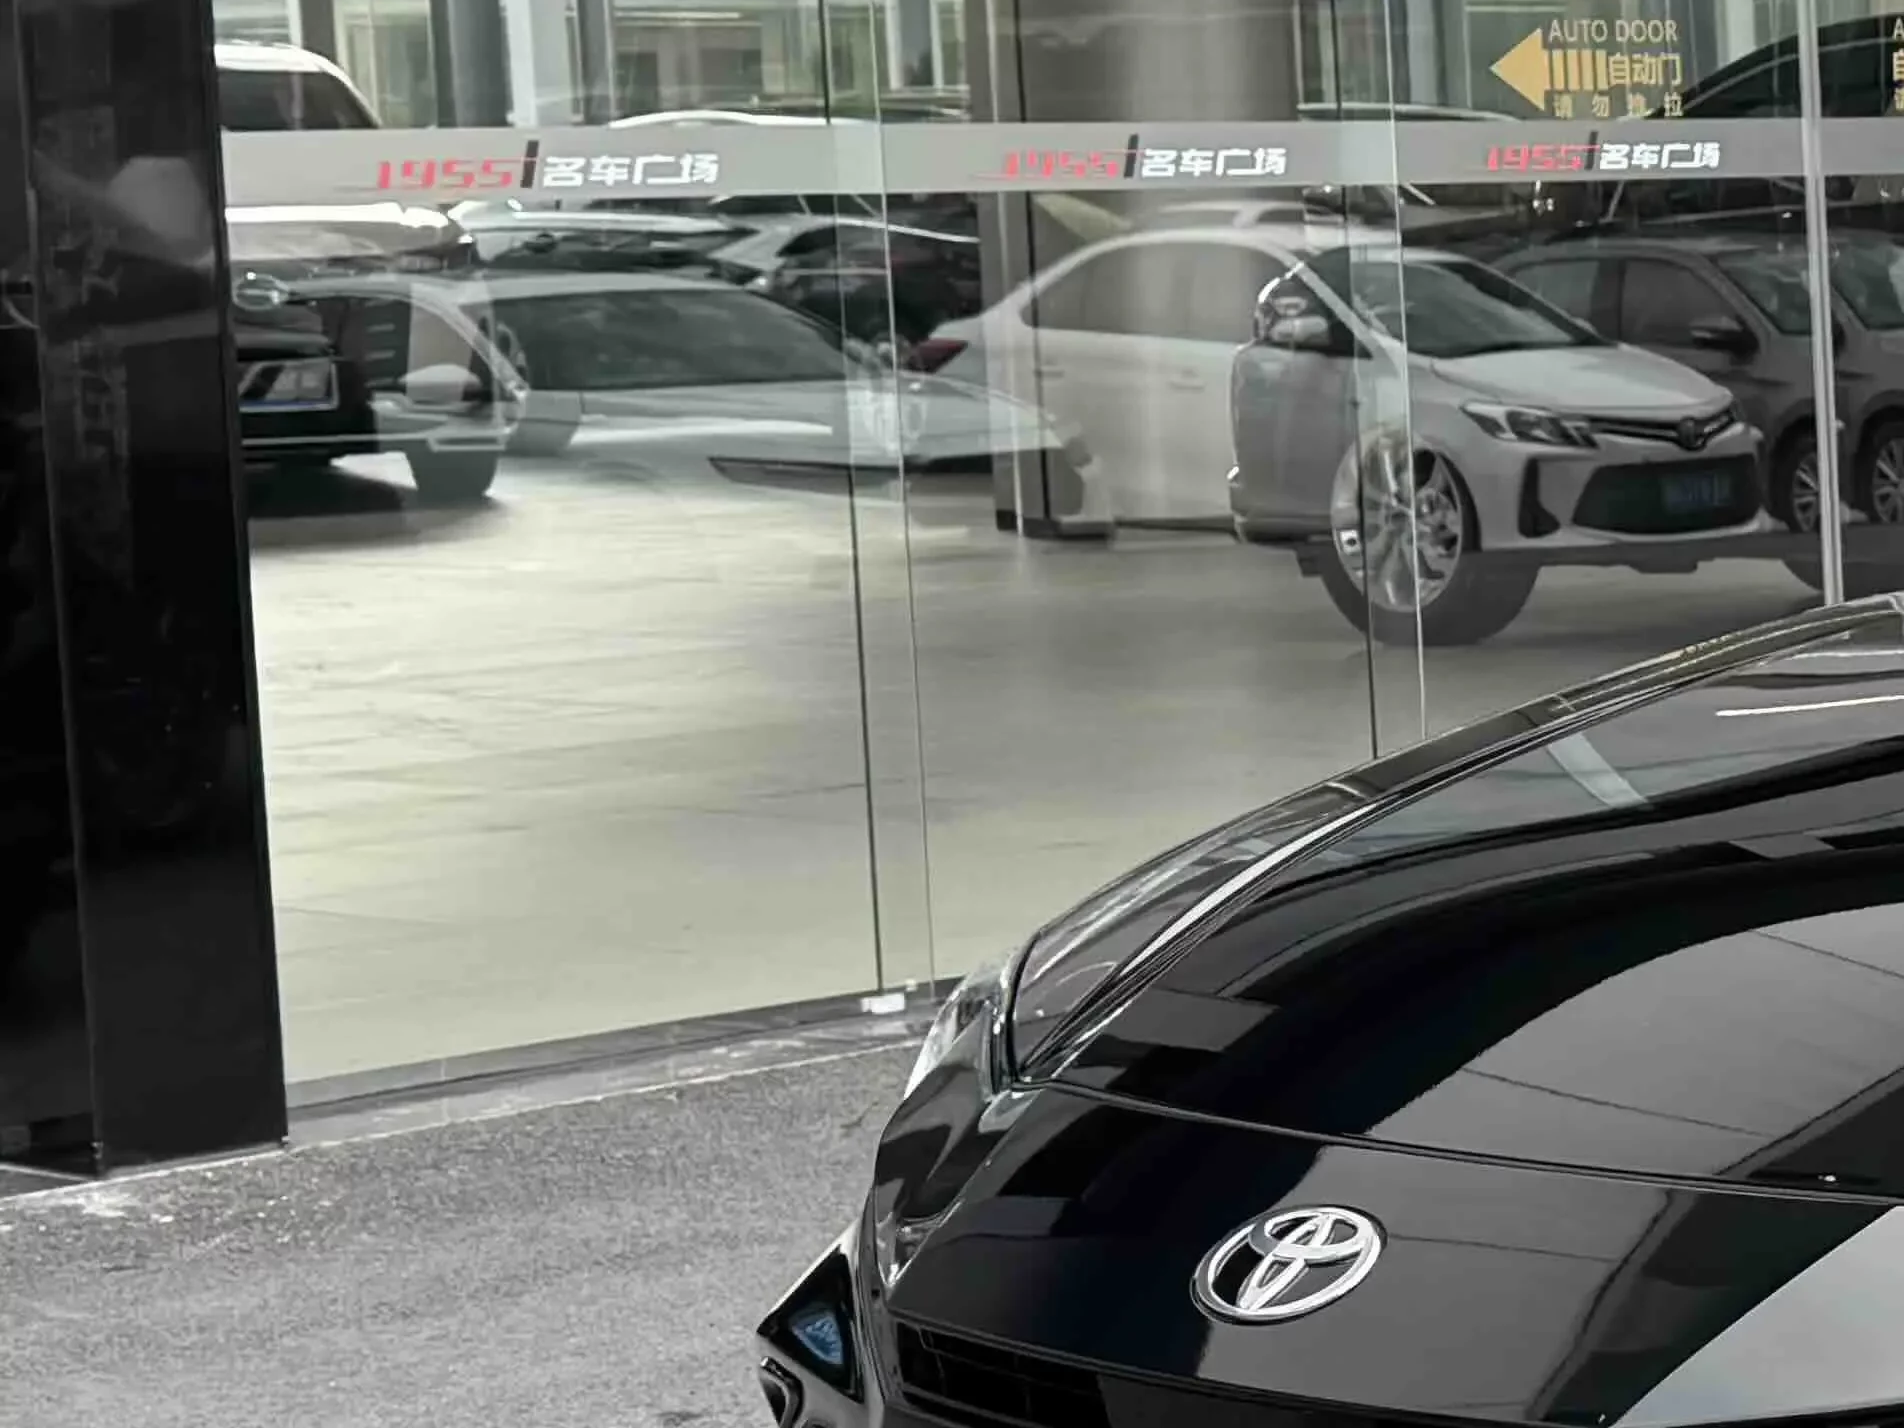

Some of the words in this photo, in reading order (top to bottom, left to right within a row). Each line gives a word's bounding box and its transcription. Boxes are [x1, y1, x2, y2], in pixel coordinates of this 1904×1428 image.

[1549, 19, 1608, 42] AUTO
[1615, 20, 1679, 43] DOOR
[1608, 52, 1682, 86] 自动门
[1141, 147, 1287, 177] 名车广场
[1487, 143, 1588, 171] 1955
[1599, 141, 1721, 169] 名车广场
[376, 158, 520, 190] 1955
[543, 153, 719, 187] 名车广场
